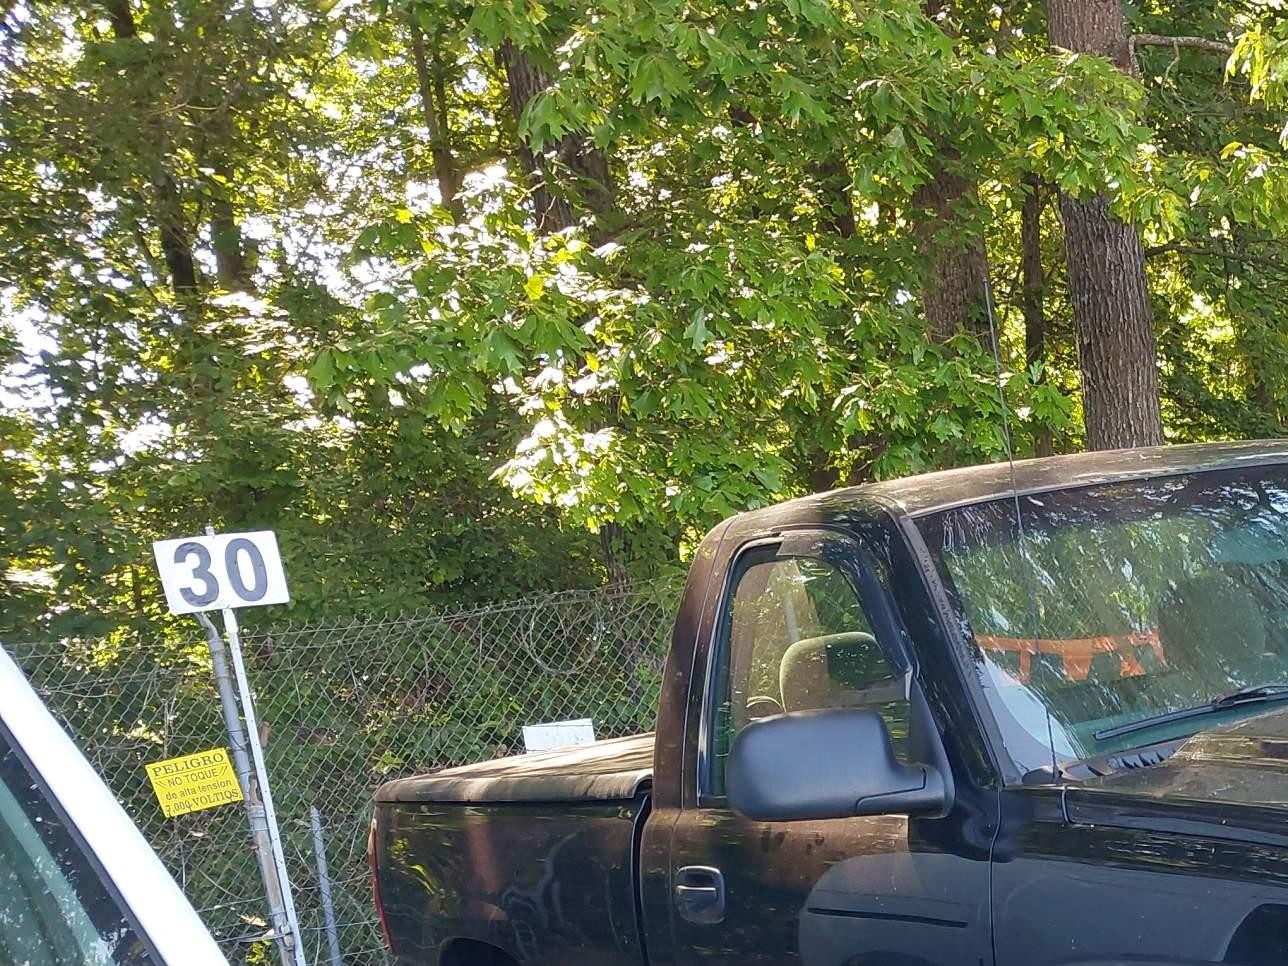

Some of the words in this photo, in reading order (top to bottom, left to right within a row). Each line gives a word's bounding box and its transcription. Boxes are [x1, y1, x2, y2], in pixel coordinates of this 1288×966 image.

[174, 537, 268, 607] 30
[152, 752, 224, 777] PELIGRO
[167, 776, 183, 788] NO
[185, 768, 219, 784] TOQUE
[165, 791, 178, 801] de
[180, 787, 197, 798] alta
[198, 779, 232, 794] tension
[192, 788, 239, 807] VOLTIOS
